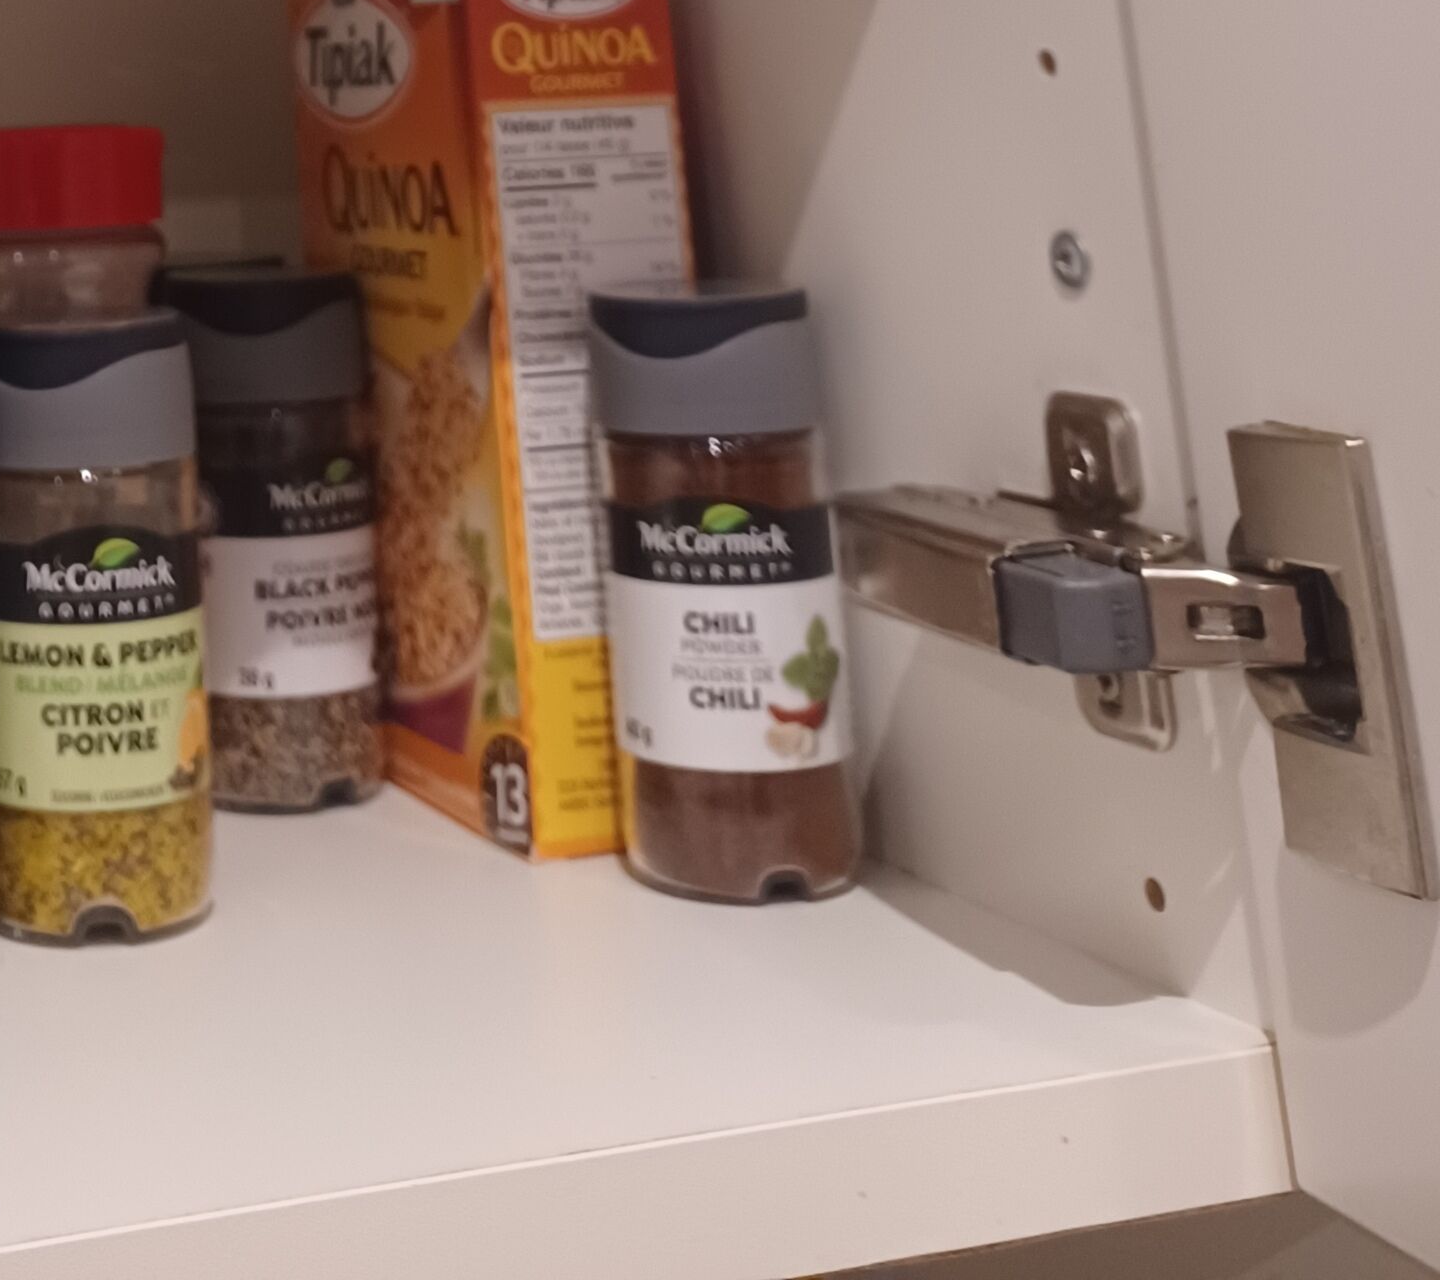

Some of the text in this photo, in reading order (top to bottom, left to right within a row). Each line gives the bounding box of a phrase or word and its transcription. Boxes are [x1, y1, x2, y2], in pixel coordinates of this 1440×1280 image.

[303, 22, 395, 106] Tipiak
[530, 72, 625, 93] GOURMET
[560, 115, 635, 131] nutritive
[267, 479, 368, 511] McCorm
[637, 520, 793, 556] McCormick
[21, 555, 176, 593] McCormick
[652, 559, 779, 579] GOURMET
[256, 577, 329, 601] BLACK
[38, 592, 164, 620] GOURMET
[266, 605, 347, 631] POIVRE
[683, 611, 755, 634] CHILI
[92, 643, 112, 668] &
[119, 629, 198, 665] PEPPER
[680, 640, 761, 655] POWDER
[15, 670, 82, 693] BLEND
[671, 665, 774, 682] POUDRE DE
[689, 686, 760, 710] CHILI
[41, 700, 144, 727] CITRON
[56, 728, 159, 755] POIVRE
[488, 761, 530, 825] 13
